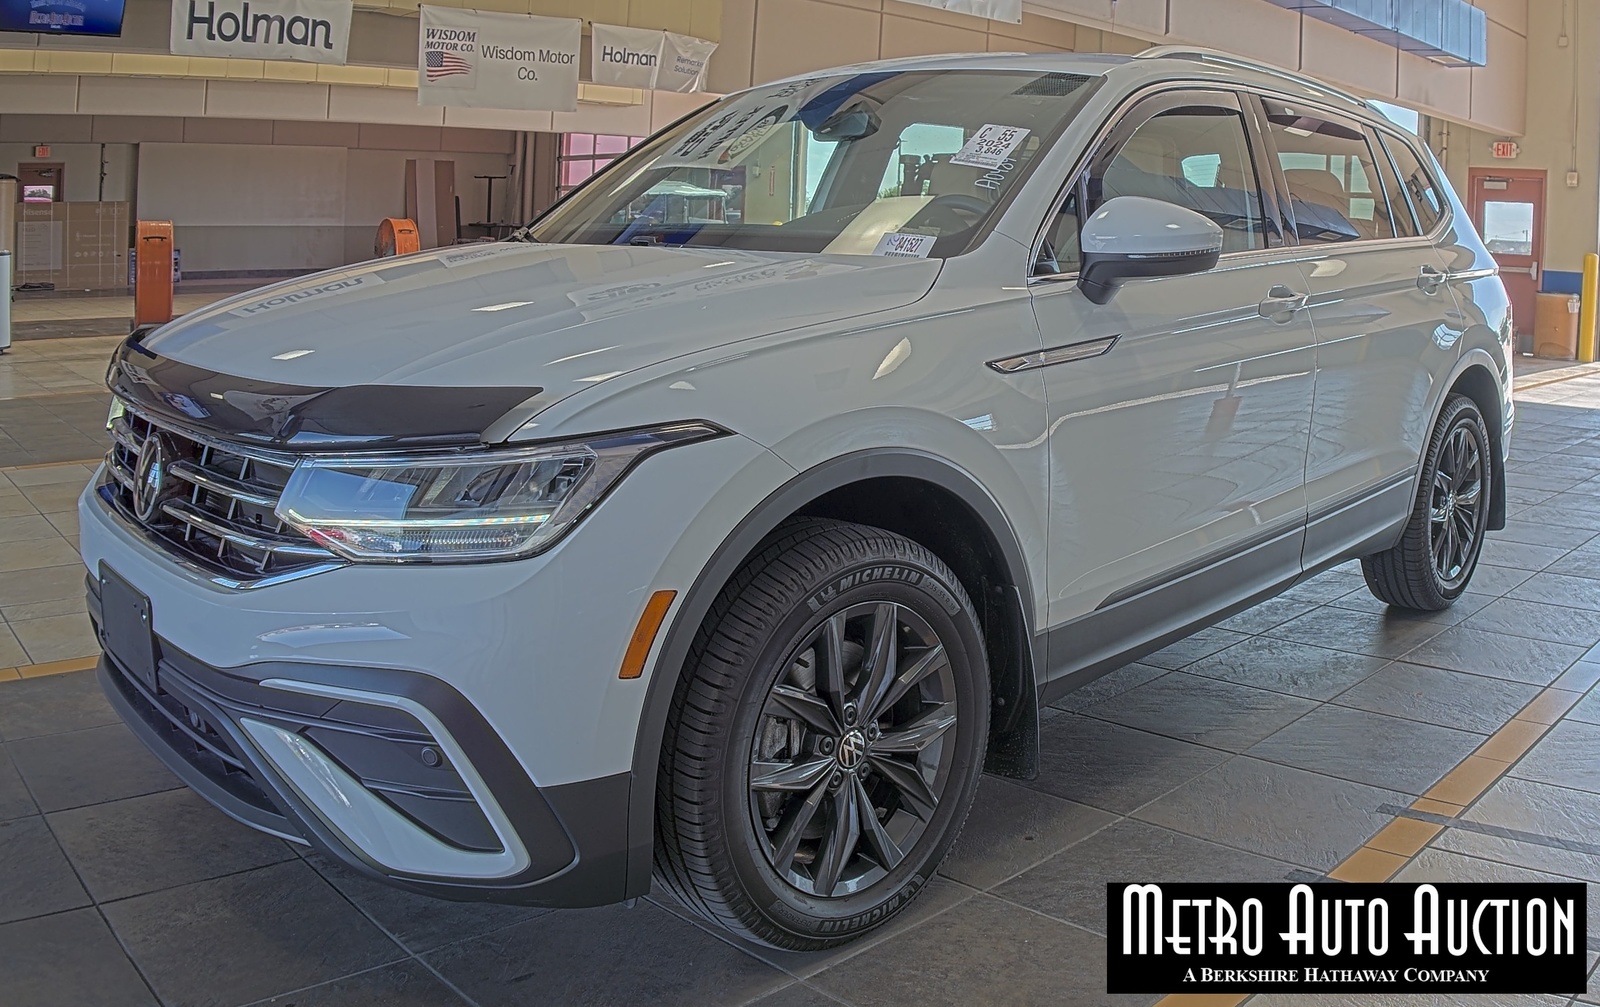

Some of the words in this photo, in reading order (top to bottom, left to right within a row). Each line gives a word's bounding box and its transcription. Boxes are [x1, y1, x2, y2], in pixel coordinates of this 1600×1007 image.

[187, 0, 333, 50] Holman
[426, 28, 477, 42] WISDOM
[425, 41, 459, 51] MOTOR
[460, 43, 475, 52] CO.
[481, 44, 536, 62] Wisdom
[538, 49, 575, 65] Motor
[602, 45, 657, 67] Holman
[517, 66, 538, 81] Co.
[979, 127, 993, 139] C
[998, 129, 1018, 142] 55
[977, 138, 1012, 150] 2024
[1496, 143, 1514, 157] EXIT
[839, 566, 922, 592] MICHELIN
[820, 896, 900, 933] MICHELIN
